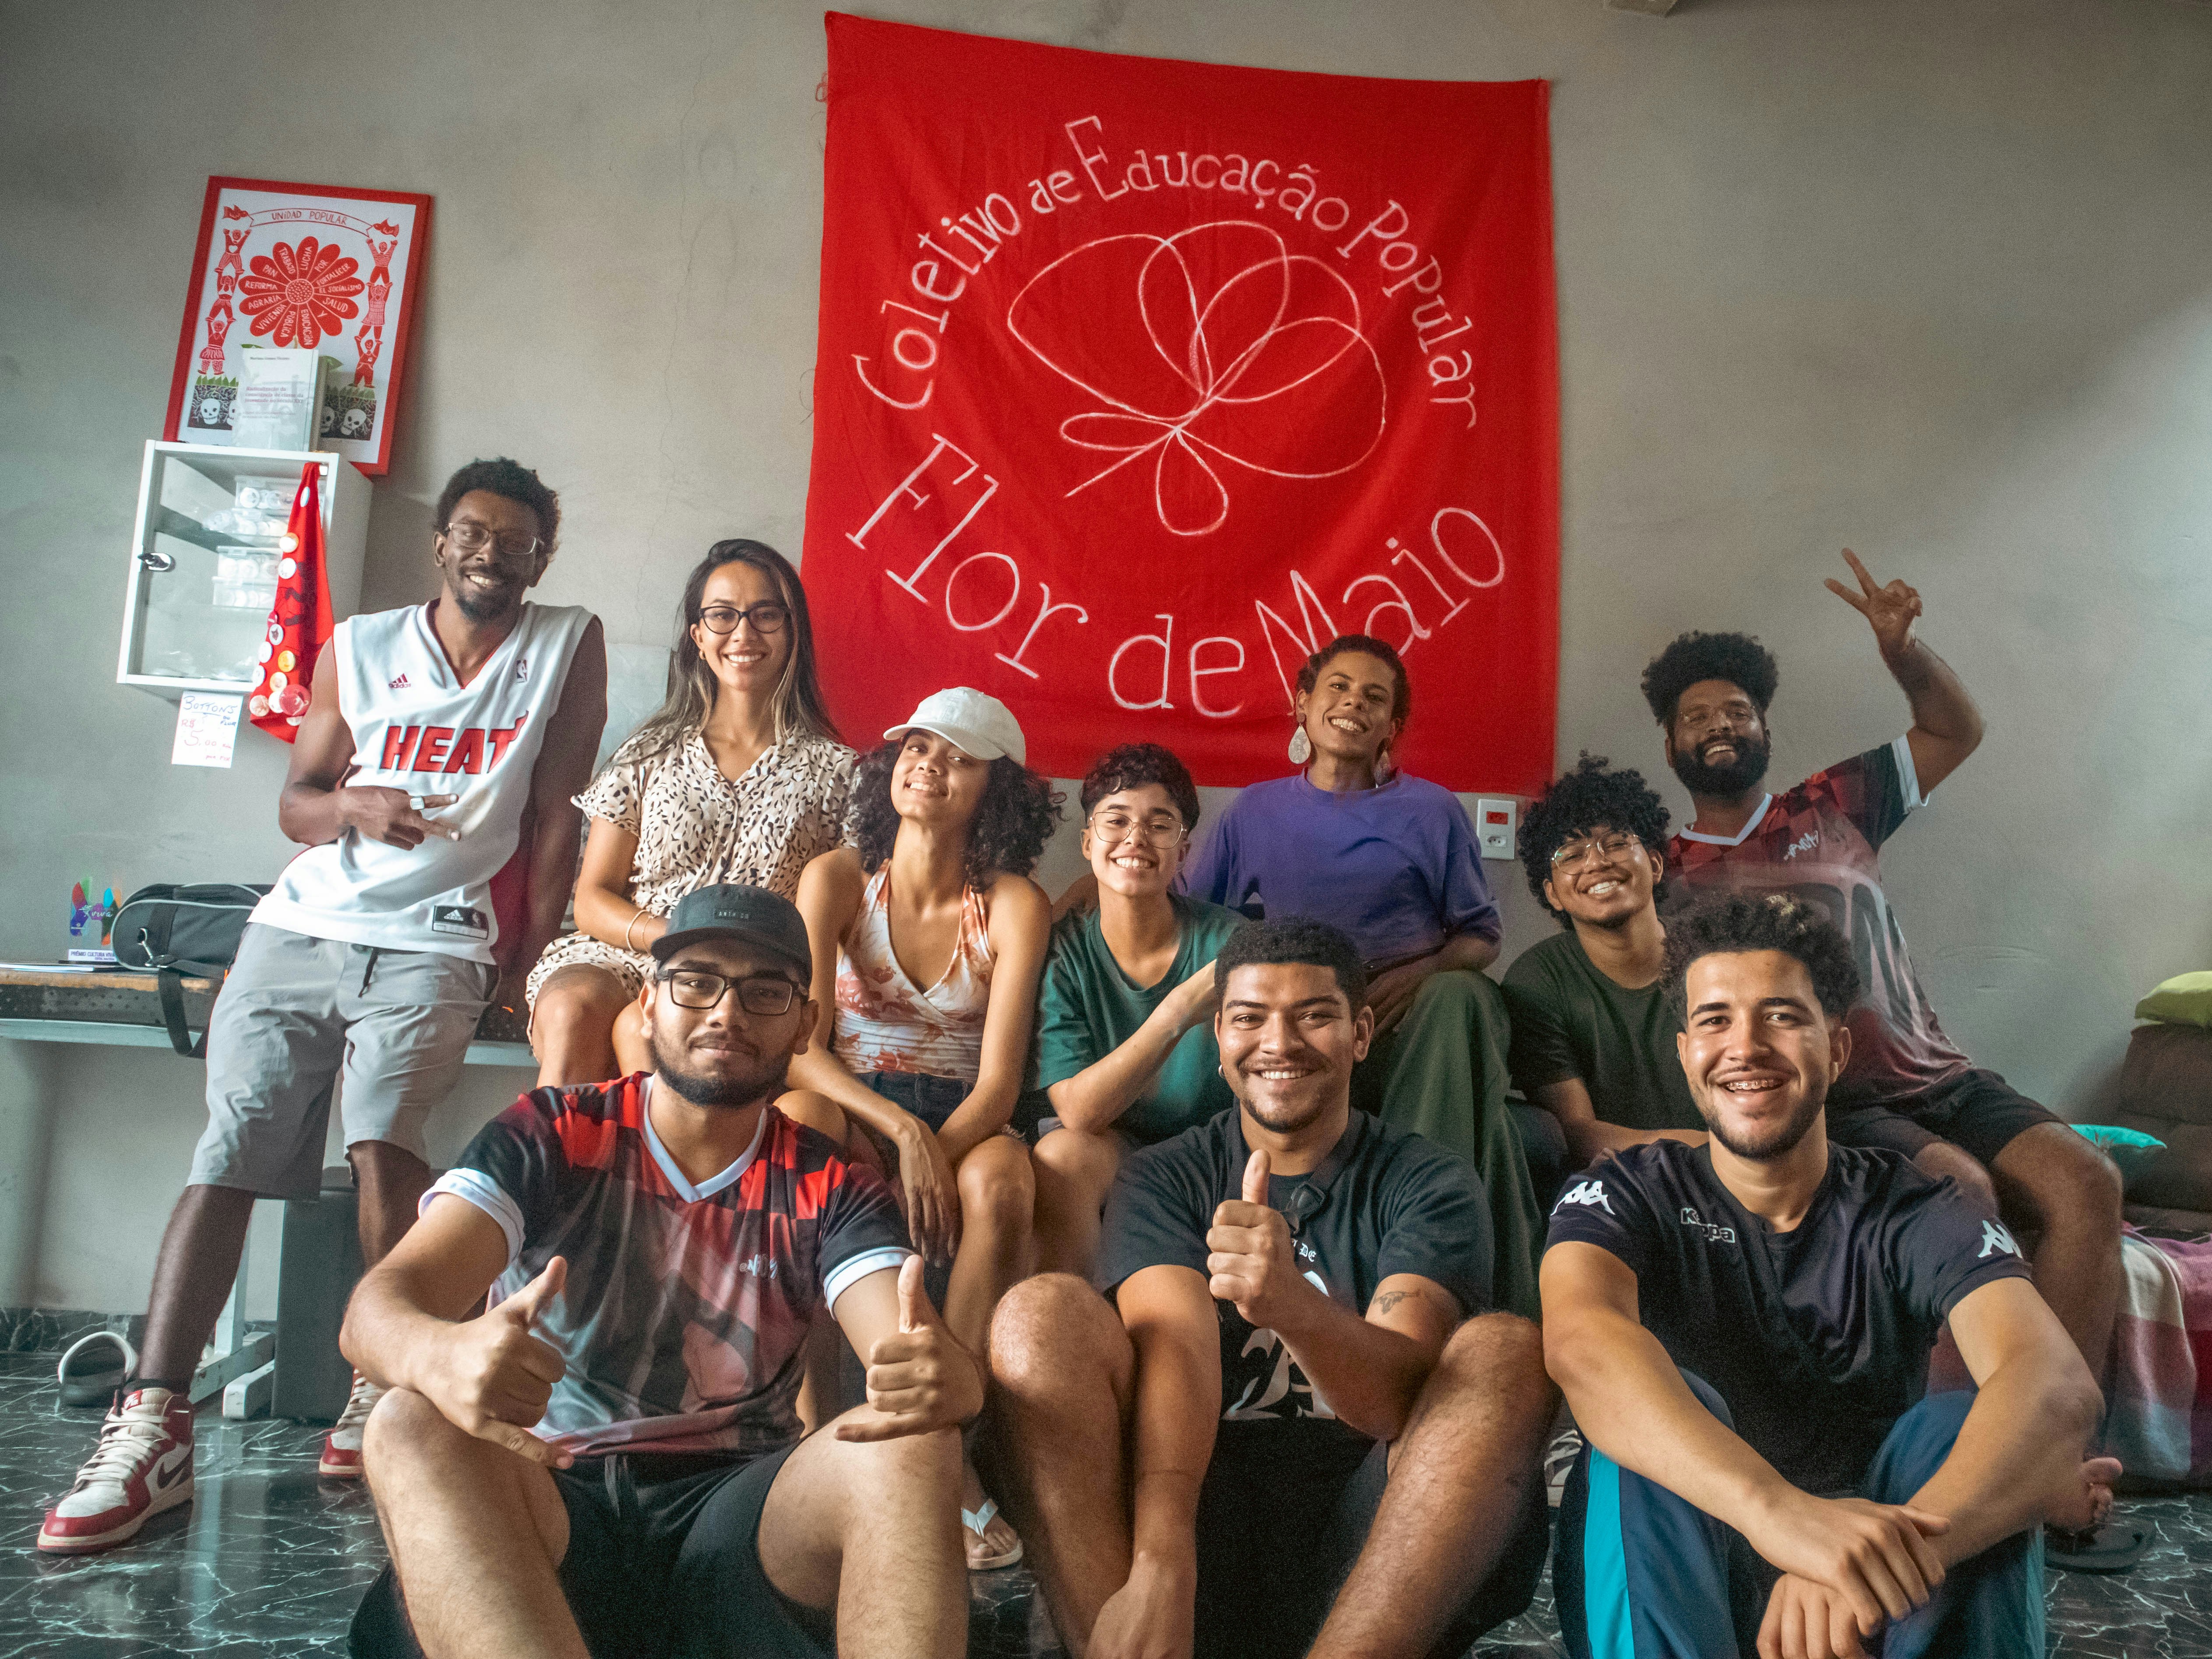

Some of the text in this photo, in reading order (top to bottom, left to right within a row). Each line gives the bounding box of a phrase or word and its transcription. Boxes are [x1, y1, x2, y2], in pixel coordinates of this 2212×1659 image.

[271, 211, 347, 225] UNIDAD POPULAR
[279, 247, 296, 274] TRABAJO
[301, 246, 312, 270] LUCHA
[314, 259, 328, 272] POR
[262, 264, 278, 277] PAN
[852, 115, 1478, 429] Coletivo de Educação Popular
[245, 280, 278, 290] REFORMA
[248, 294, 282, 310] AGRARIA
[322, 297, 349, 312] SALUD
[845, 433, 1088, 679] Flor
[1108, 614, 1245, 718] de
[379, 710, 529, 775] HEAT
